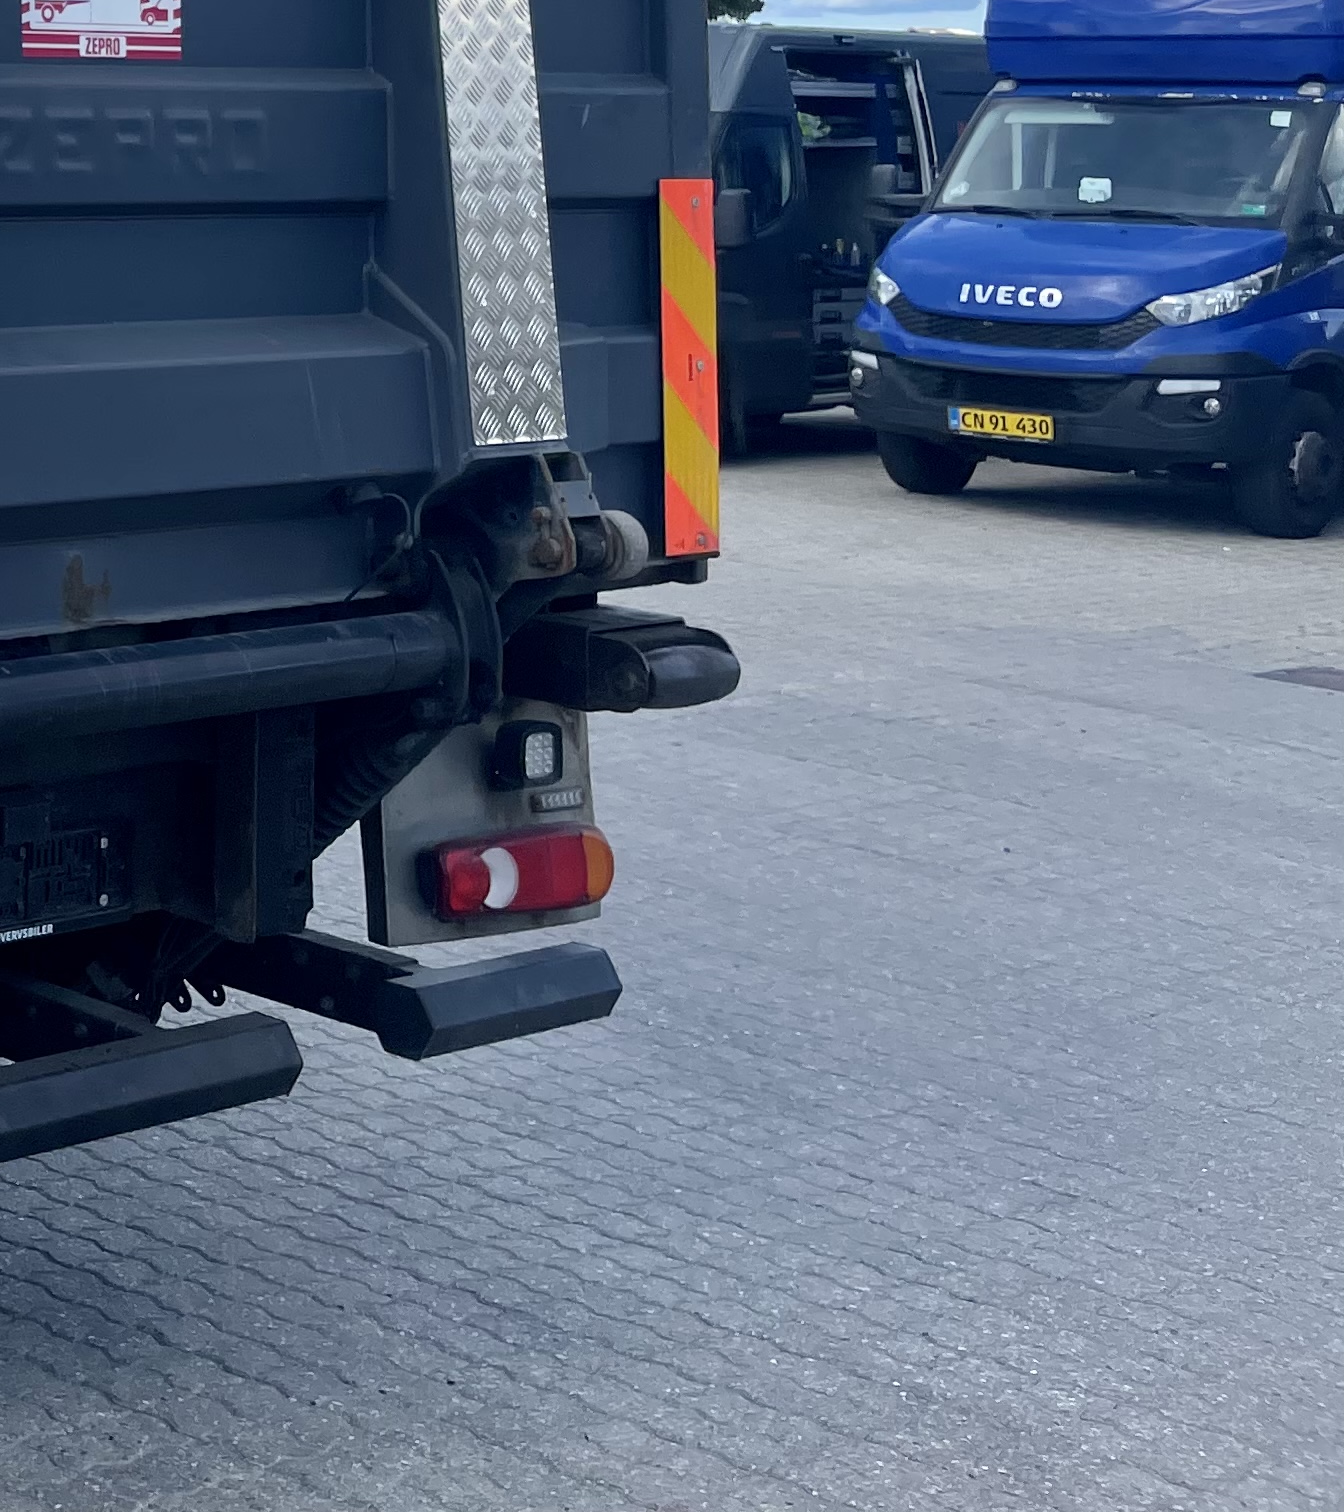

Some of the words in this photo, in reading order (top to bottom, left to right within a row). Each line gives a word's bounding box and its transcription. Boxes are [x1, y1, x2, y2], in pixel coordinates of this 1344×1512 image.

[84, 37, 121, 56] ZEPRO
[959, 283, 1063, 308] IVECO
[961, 412, 984, 429] CN
[989, 414, 1009, 432] 91
[1016, 417, 1050, 435] 430
